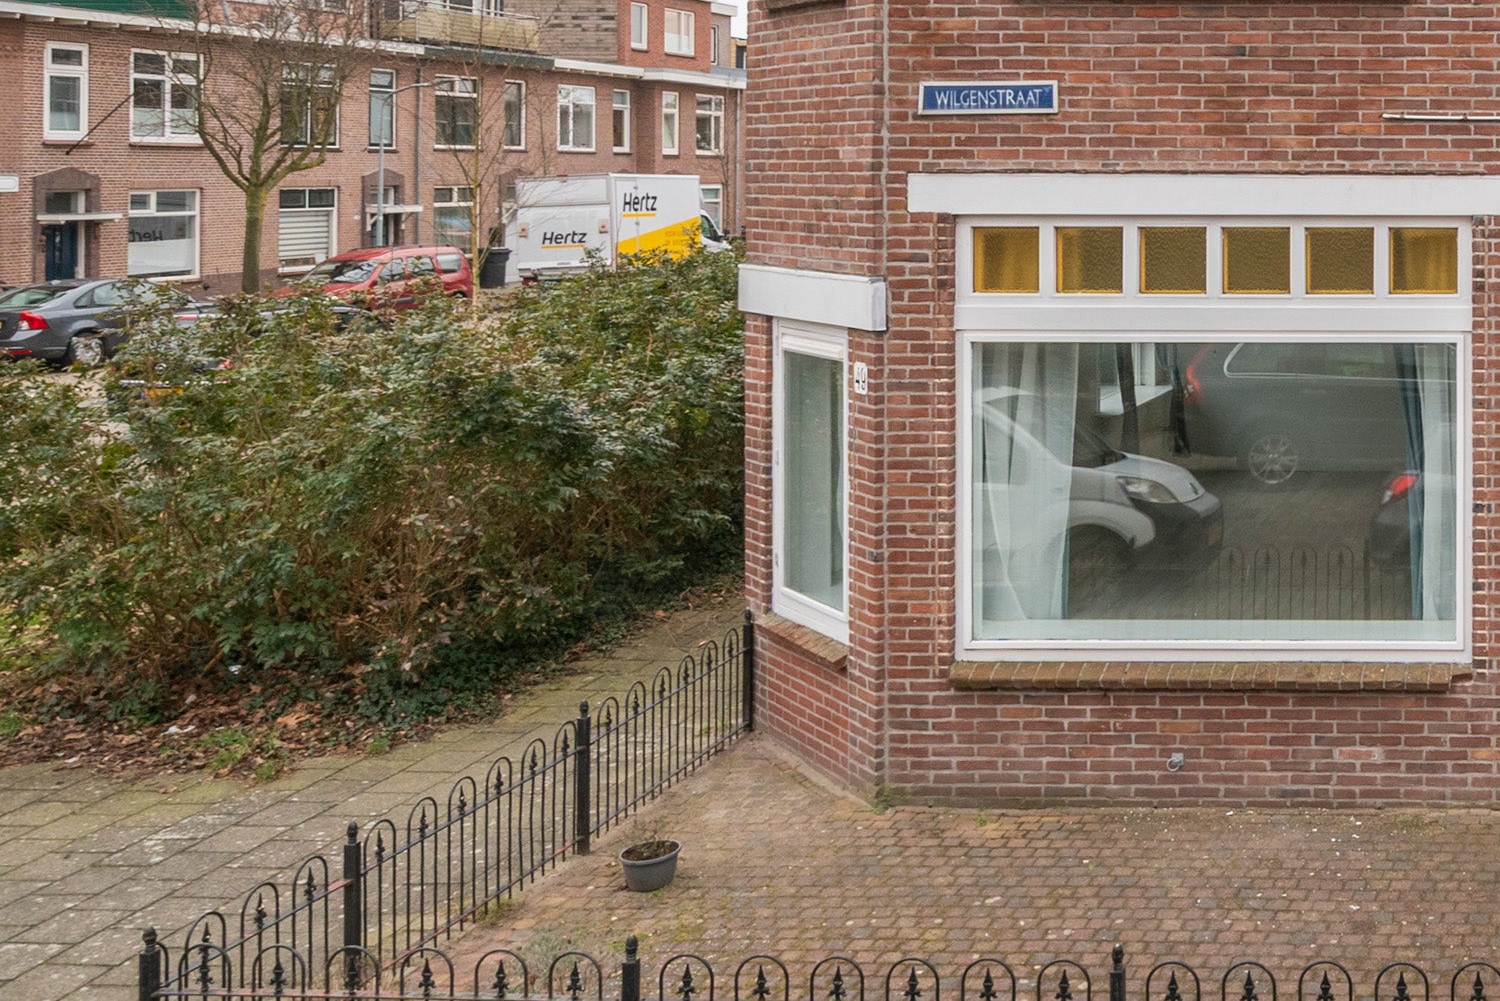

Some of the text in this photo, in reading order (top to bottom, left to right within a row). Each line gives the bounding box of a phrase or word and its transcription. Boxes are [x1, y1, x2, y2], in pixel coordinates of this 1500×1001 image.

[935, 89, 1043, 106] WILGENSTRAAT
[622, 192, 658, 212] Hertz
[541, 230, 588, 245] Hertz
